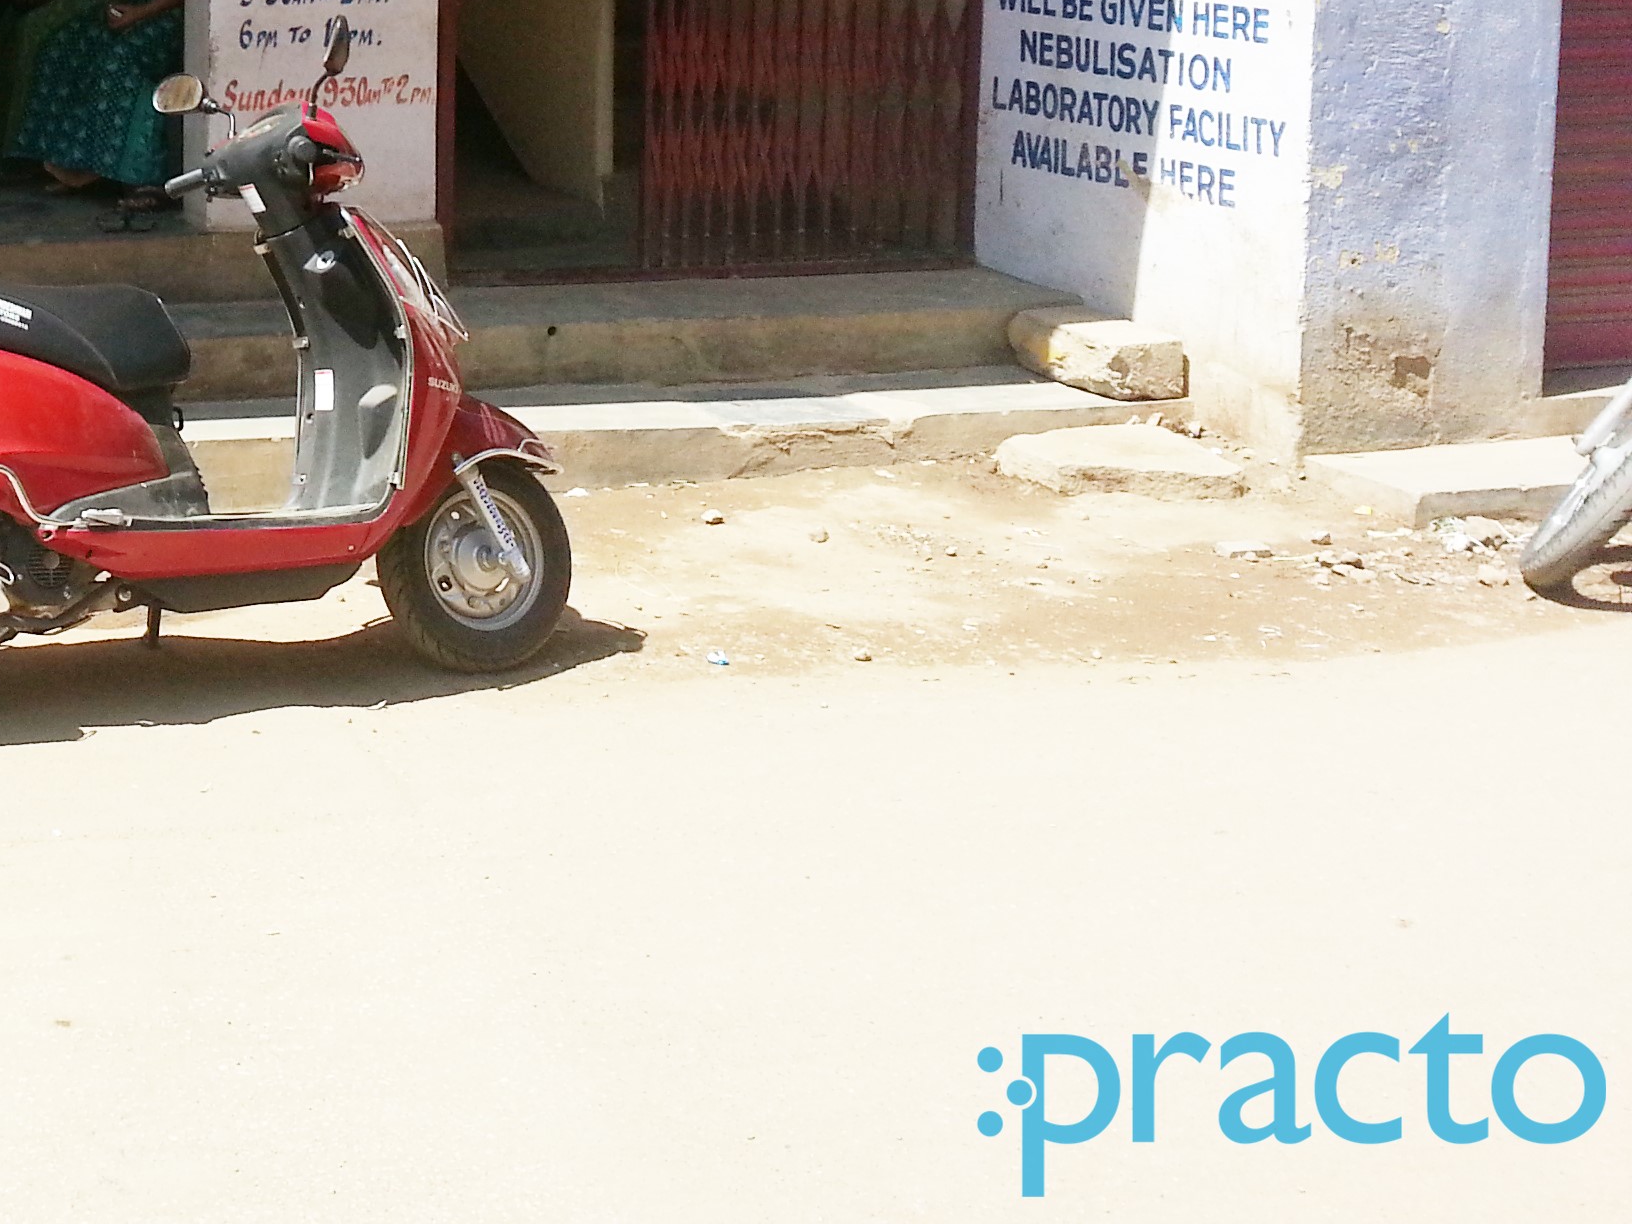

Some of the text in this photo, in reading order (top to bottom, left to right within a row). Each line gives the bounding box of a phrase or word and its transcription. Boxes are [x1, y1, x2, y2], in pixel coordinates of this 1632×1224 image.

[1192, 1, 1269, 44] HERE
[1019, 29, 1232, 94] NEBULISATION
[991, 76, 1287, 158] LABORATORY FACILITY
[1011, 129, 1236, 209] AVAILABLE HERE
